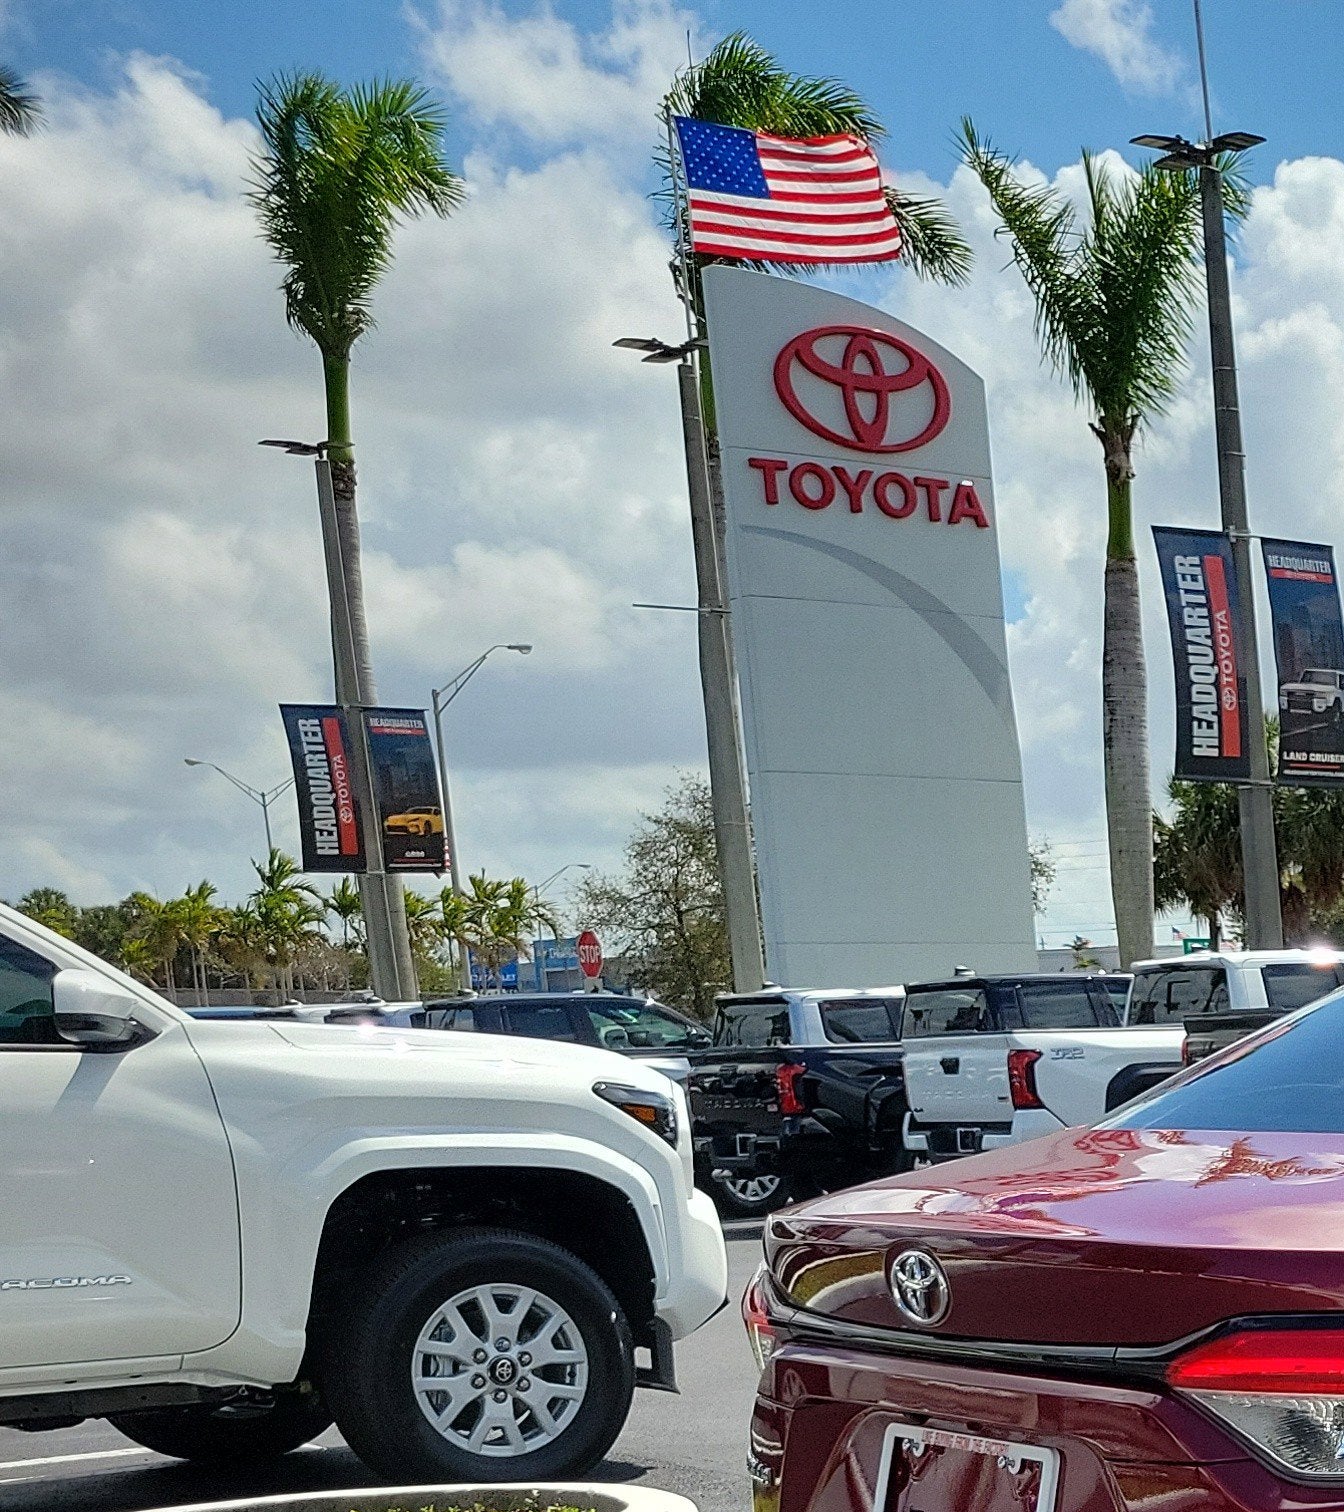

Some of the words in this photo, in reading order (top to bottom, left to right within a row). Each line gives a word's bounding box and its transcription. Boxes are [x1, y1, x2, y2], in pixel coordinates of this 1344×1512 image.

[748, 457, 990, 528] TOYOTA
[1174, 555, 1220, 757] HEADQUARTER
[1214, 610, 1234, 685] TOYOTA
[333, 754, 352, 805] TOYOTA
[1283, 751, 1308, 761] LAND
[298, 718, 340, 856] HEADQUARTER
[580, 945, 601, 964] STOP
[0, 1274, 132, 1290] ACOMA
